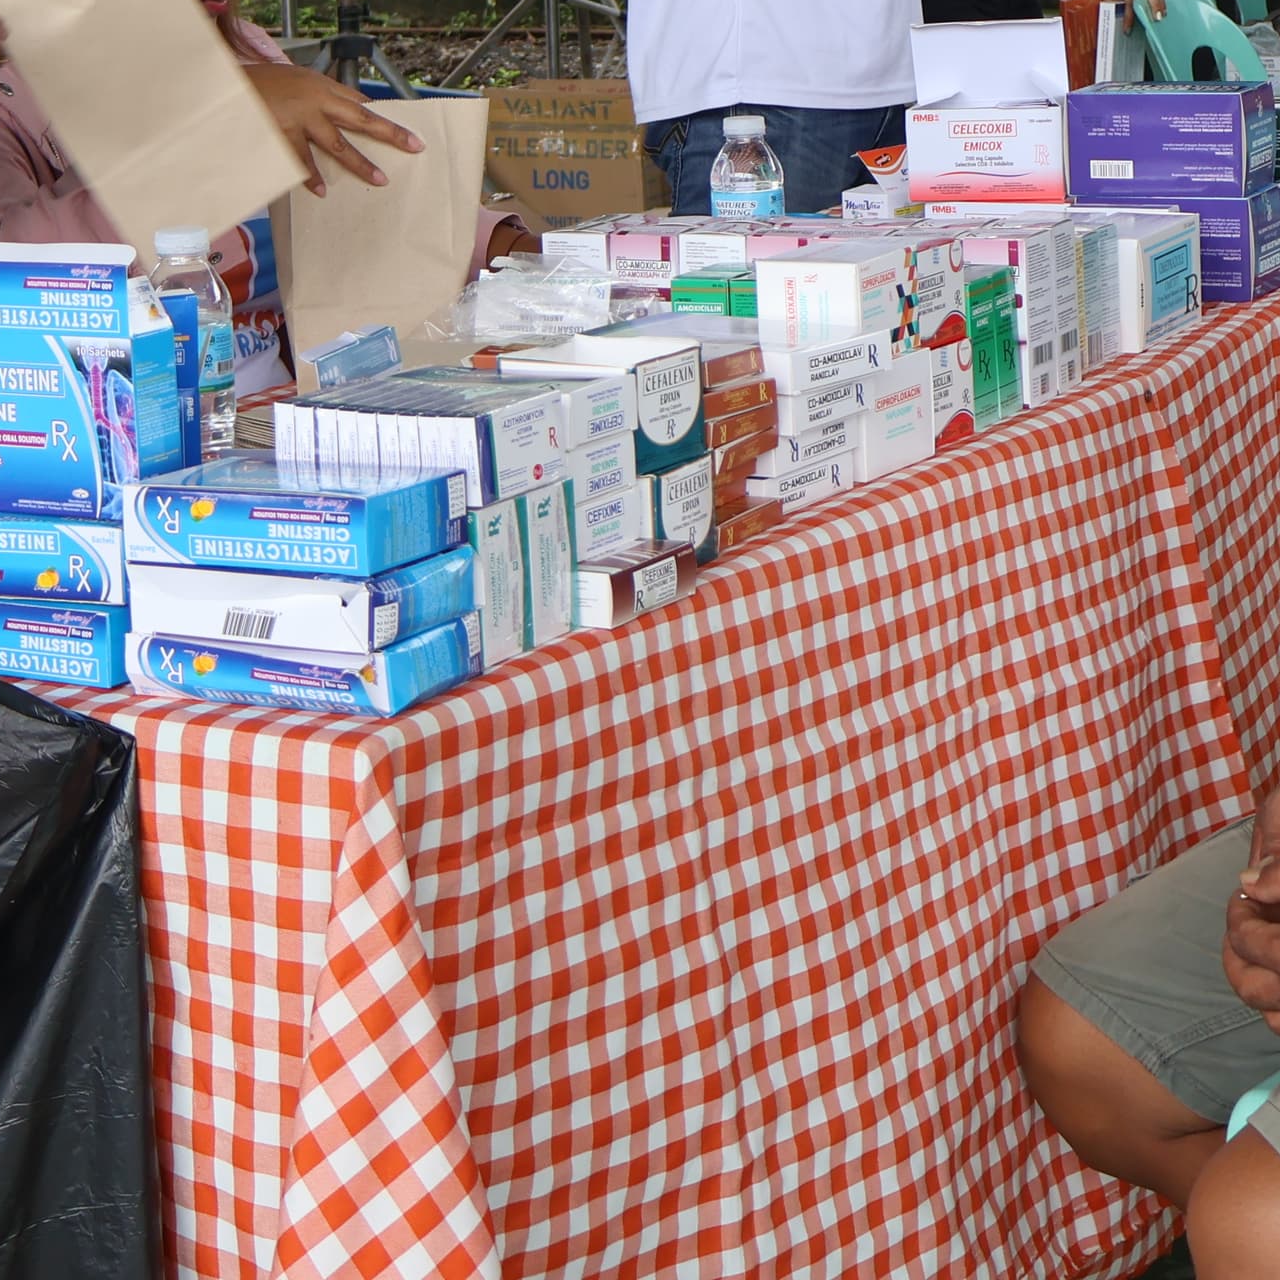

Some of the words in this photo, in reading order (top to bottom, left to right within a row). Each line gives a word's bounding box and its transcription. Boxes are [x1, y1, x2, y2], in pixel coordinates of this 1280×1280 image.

[503, 97, 613, 120] VALIANT
[952, 123, 1013, 135] CELECOXIB
[493, 137, 538, 158] FILE
[963, 141, 1003, 152] EMICOX
[532, 168, 590, 190] LONG
[716, 200, 757, 209] NATURE'S
[718, 208, 751, 216] SPRING
[617, 261, 669, 270] CO-AMOXICLAV
[40, 291, 114, 308] CILESTINE
[677, 303, 722, 314] AMOXICILLIN
[76, 346, 86, 356] 10
[88, 346, 126, 358] Sachets
[809, 346, 863, 369] CO-AMOXICLAV
[645, 365, 695, 392] CEFALEXIN
[810, 368, 840, 382] RANICLAV
[808, 385, 852, 409] CO-AMOXICLAV
[876, 386, 921, 410] CIPROFLOXACIN
[589, 414, 624, 435] CEFIXIME
[809, 407, 833, 422] RANICLAV
[803, 434, 846, 457] CO-AMOXICLAV
[588, 471, 622, 493] CEFIXIME
[669, 471, 709, 501] CEFALEXIN
[780, 467, 827, 492] CO-AMOXICLAV
[587, 500, 622, 524] CEFIXIME
[268, 523, 351, 541] CILESTINE
[194, 539, 351, 565] ACETYLCYSTEINE
[20, 635, 94, 654] CILESTINE
[270, 685, 356, 703] CILESTINE
